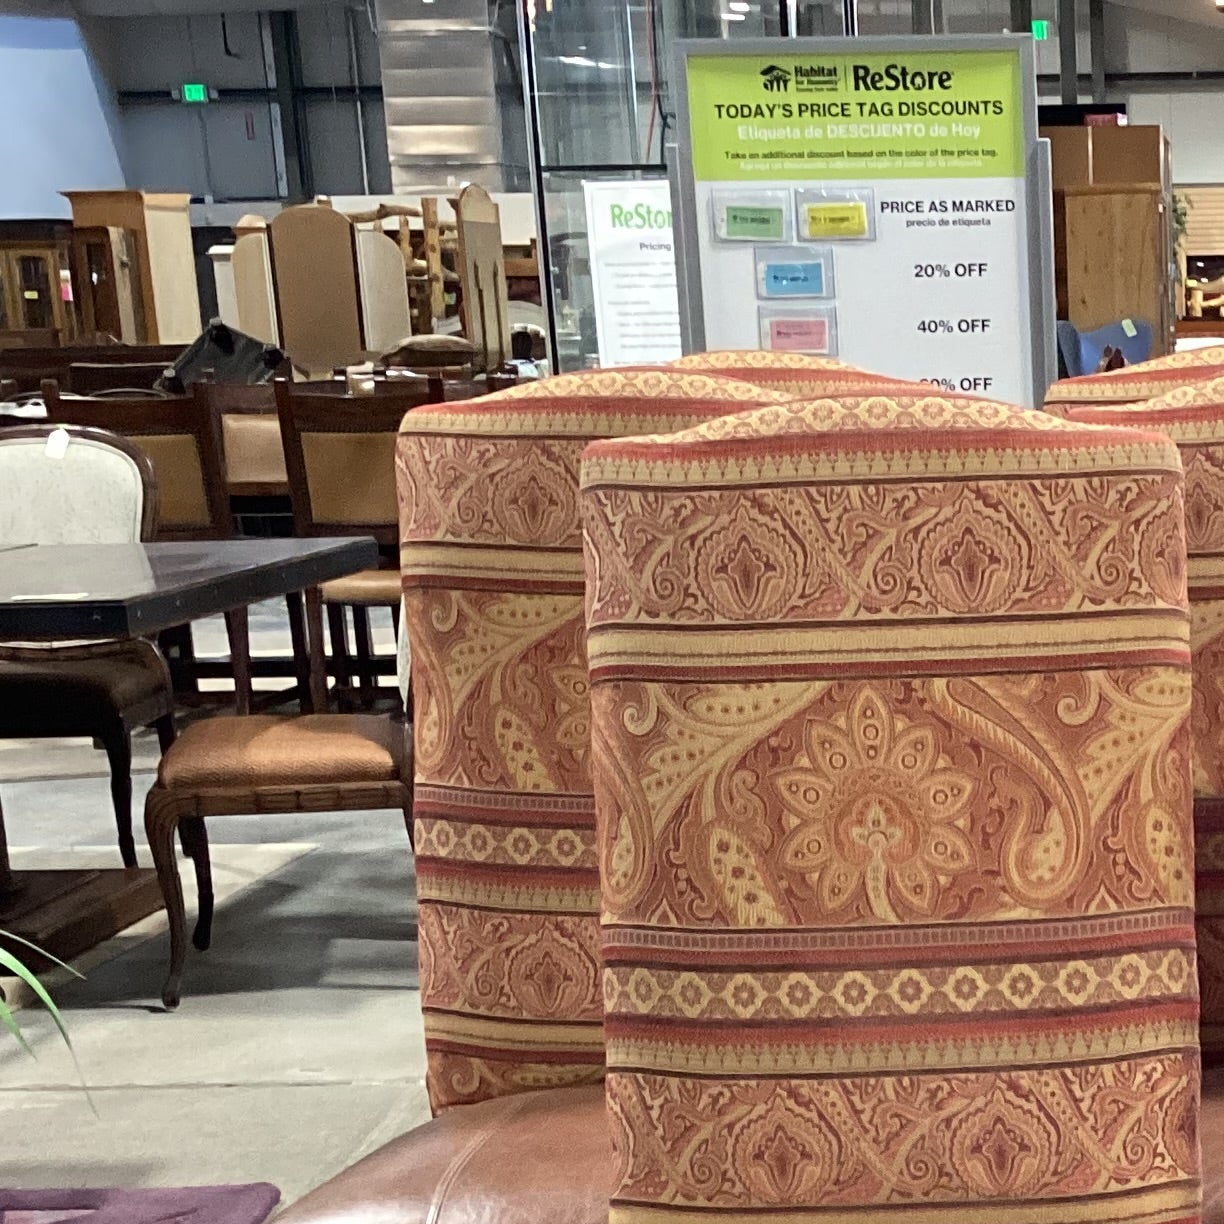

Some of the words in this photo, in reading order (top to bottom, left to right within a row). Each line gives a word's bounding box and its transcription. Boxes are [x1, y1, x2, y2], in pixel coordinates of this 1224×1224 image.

[794, 65, 838, 77] Habitat
[853, 64, 952, 91] ReStore
[714, 103, 793, 119] TODAY'S
[797, 102, 852, 118] PRICE
[856, 102, 893, 117] TAG
[898, 100, 1003, 116] DISCOUNTS
[737, 124, 800, 141] Etiqueta
[804, 124, 823, 139] de
[827, 123, 925, 138] DESCUENTO
[929, 123, 948, 137] de
[951, 122, 980, 140] Hoy
[725, 151, 746, 159] Take
[761, 150, 805, 159] additional
[807, 150, 844, 159] discount
[846, 150, 873, 158] based
[888, 149, 903, 157] the
[905, 149, 926, 157] color
[929, 148, 939, 157] of
[940, 148, 954, 157] the
[957, 149, 979, 158] price
[880, 200, 924, 213] PRICE
[928, 200, 948, 213] AS
[952, 199, 1015, 213] MARKED
[906, 217, 936, 228] precio
[938, 217, 950, 226] de
[952, 217, 991, 228] etiqueta
[639, 241, 672, 252] Pricing
[914, 263, 951, 278] 20%
[955, 263, 988, 277] OFF
[917, 319, 954, 333] 40%
[957, 318, 991, 333] OFF
[960, 377, 993, 391] OFF
